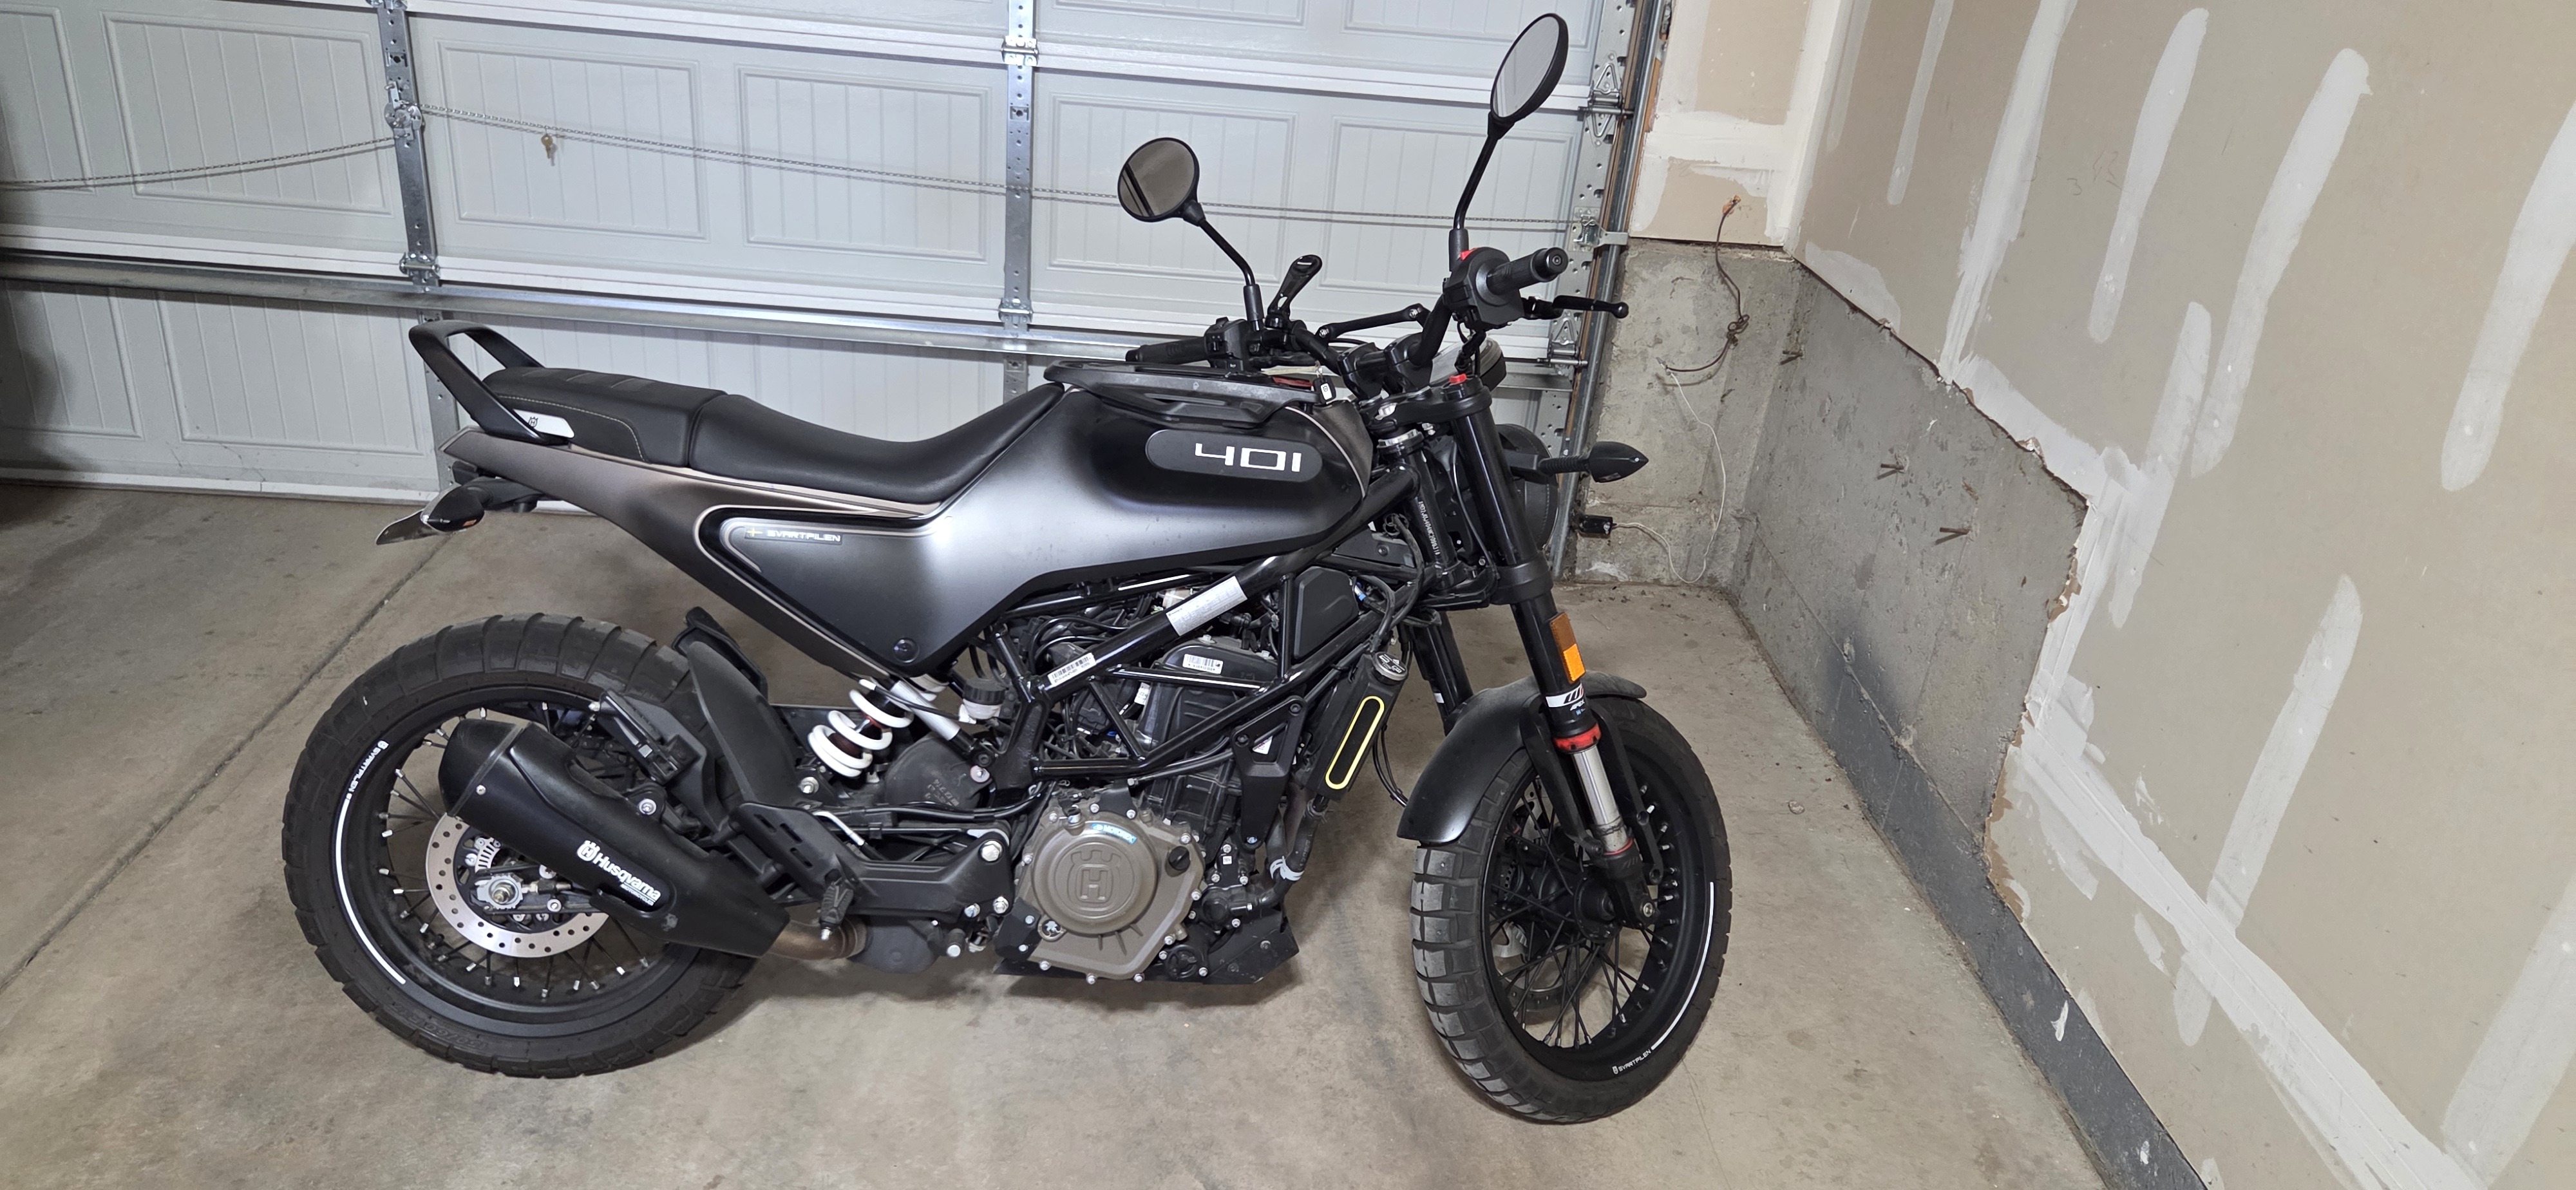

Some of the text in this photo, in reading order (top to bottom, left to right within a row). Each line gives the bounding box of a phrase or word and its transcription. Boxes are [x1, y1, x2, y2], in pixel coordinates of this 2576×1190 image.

[1195, 442, 1302, 472] 401
[767, 529, 841, 542] SVARTPILEN
[348, 747, 381, 793] SVARTPILEN
[592, 851, 662, 902] Husqvarna
[1618, 1048, 1651, 1072] SVARTPILEN
